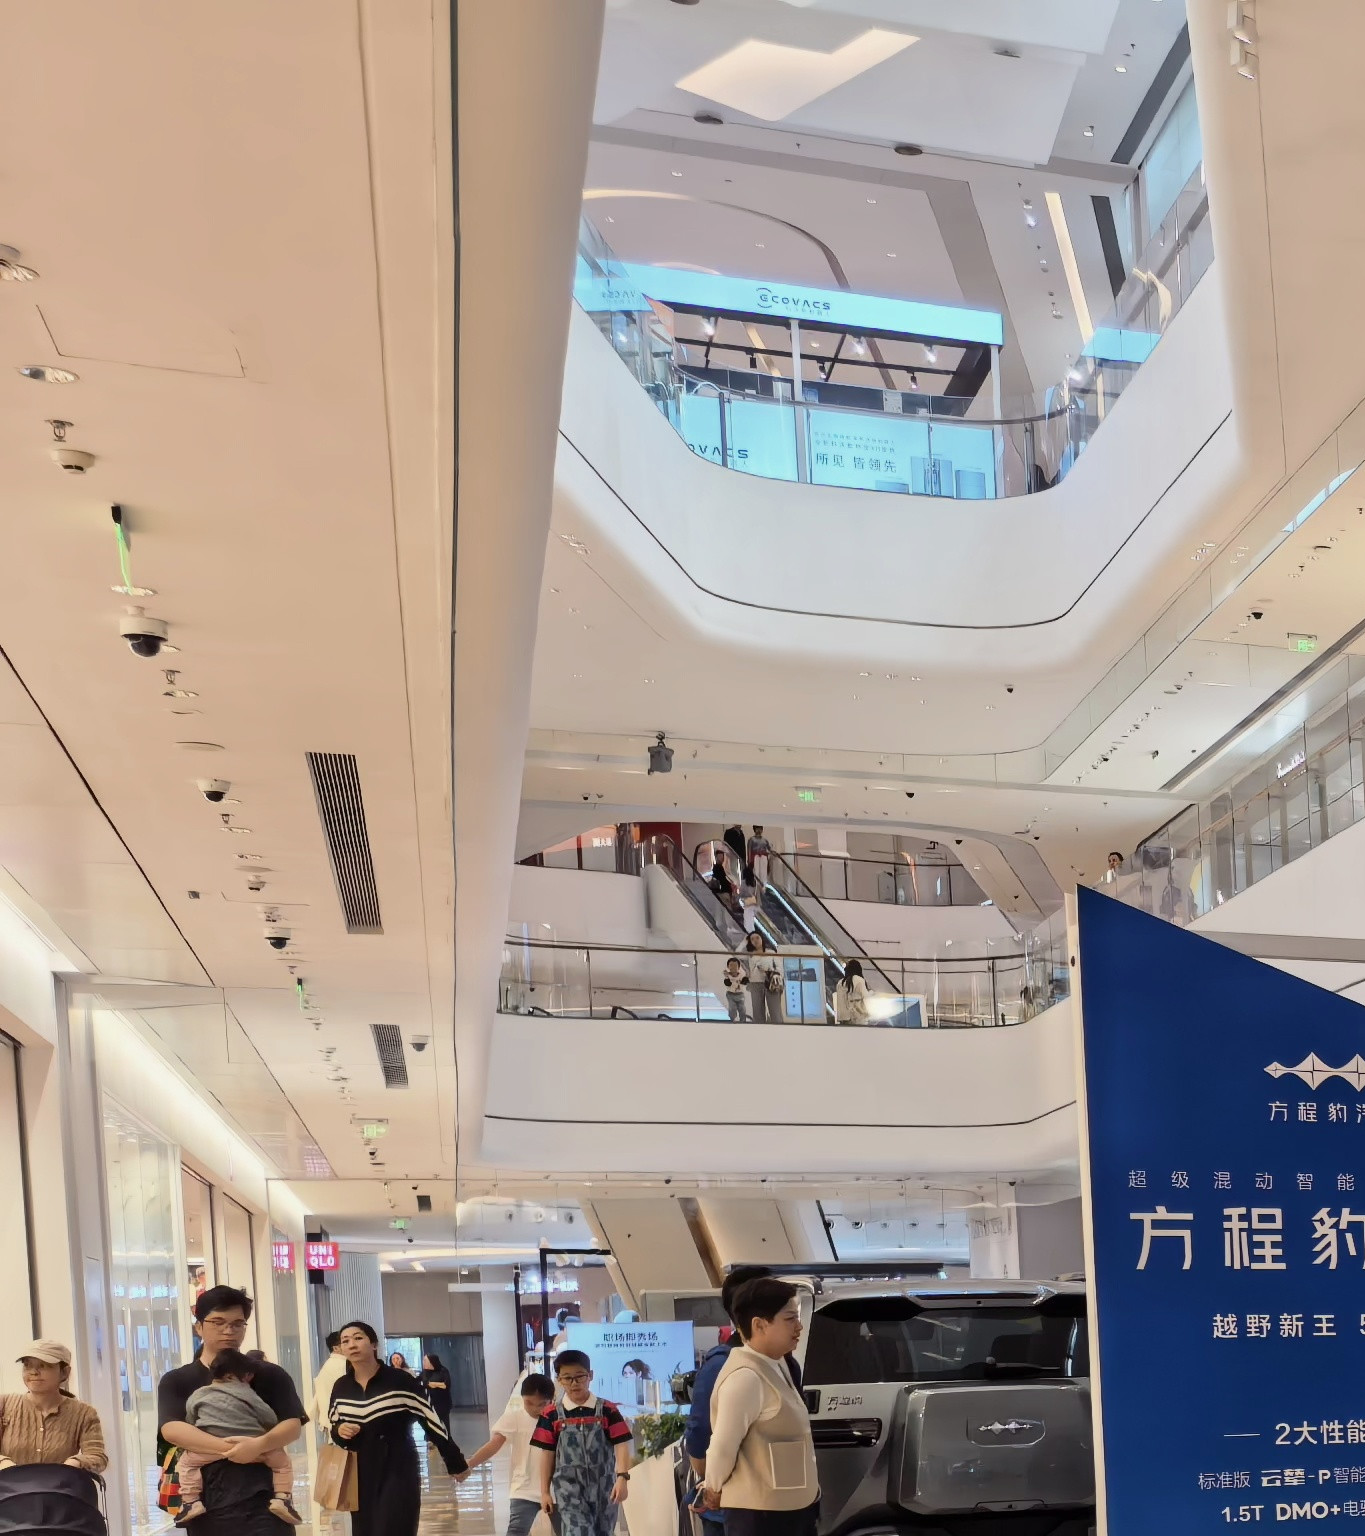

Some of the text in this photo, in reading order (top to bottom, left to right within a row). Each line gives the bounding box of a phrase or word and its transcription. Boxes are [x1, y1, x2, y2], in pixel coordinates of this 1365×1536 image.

[757, 288, 831, 310] ECOVACS
[309, 1244, 333, 1256] UNI
[309, 1256, 335, 1269] QLO
[1212, 1312, 1337, 1339] 越野新王
[1198, 1470, 1251, 1490] 标准版
[1221, 1505, 1264, 1523] 1.5T
